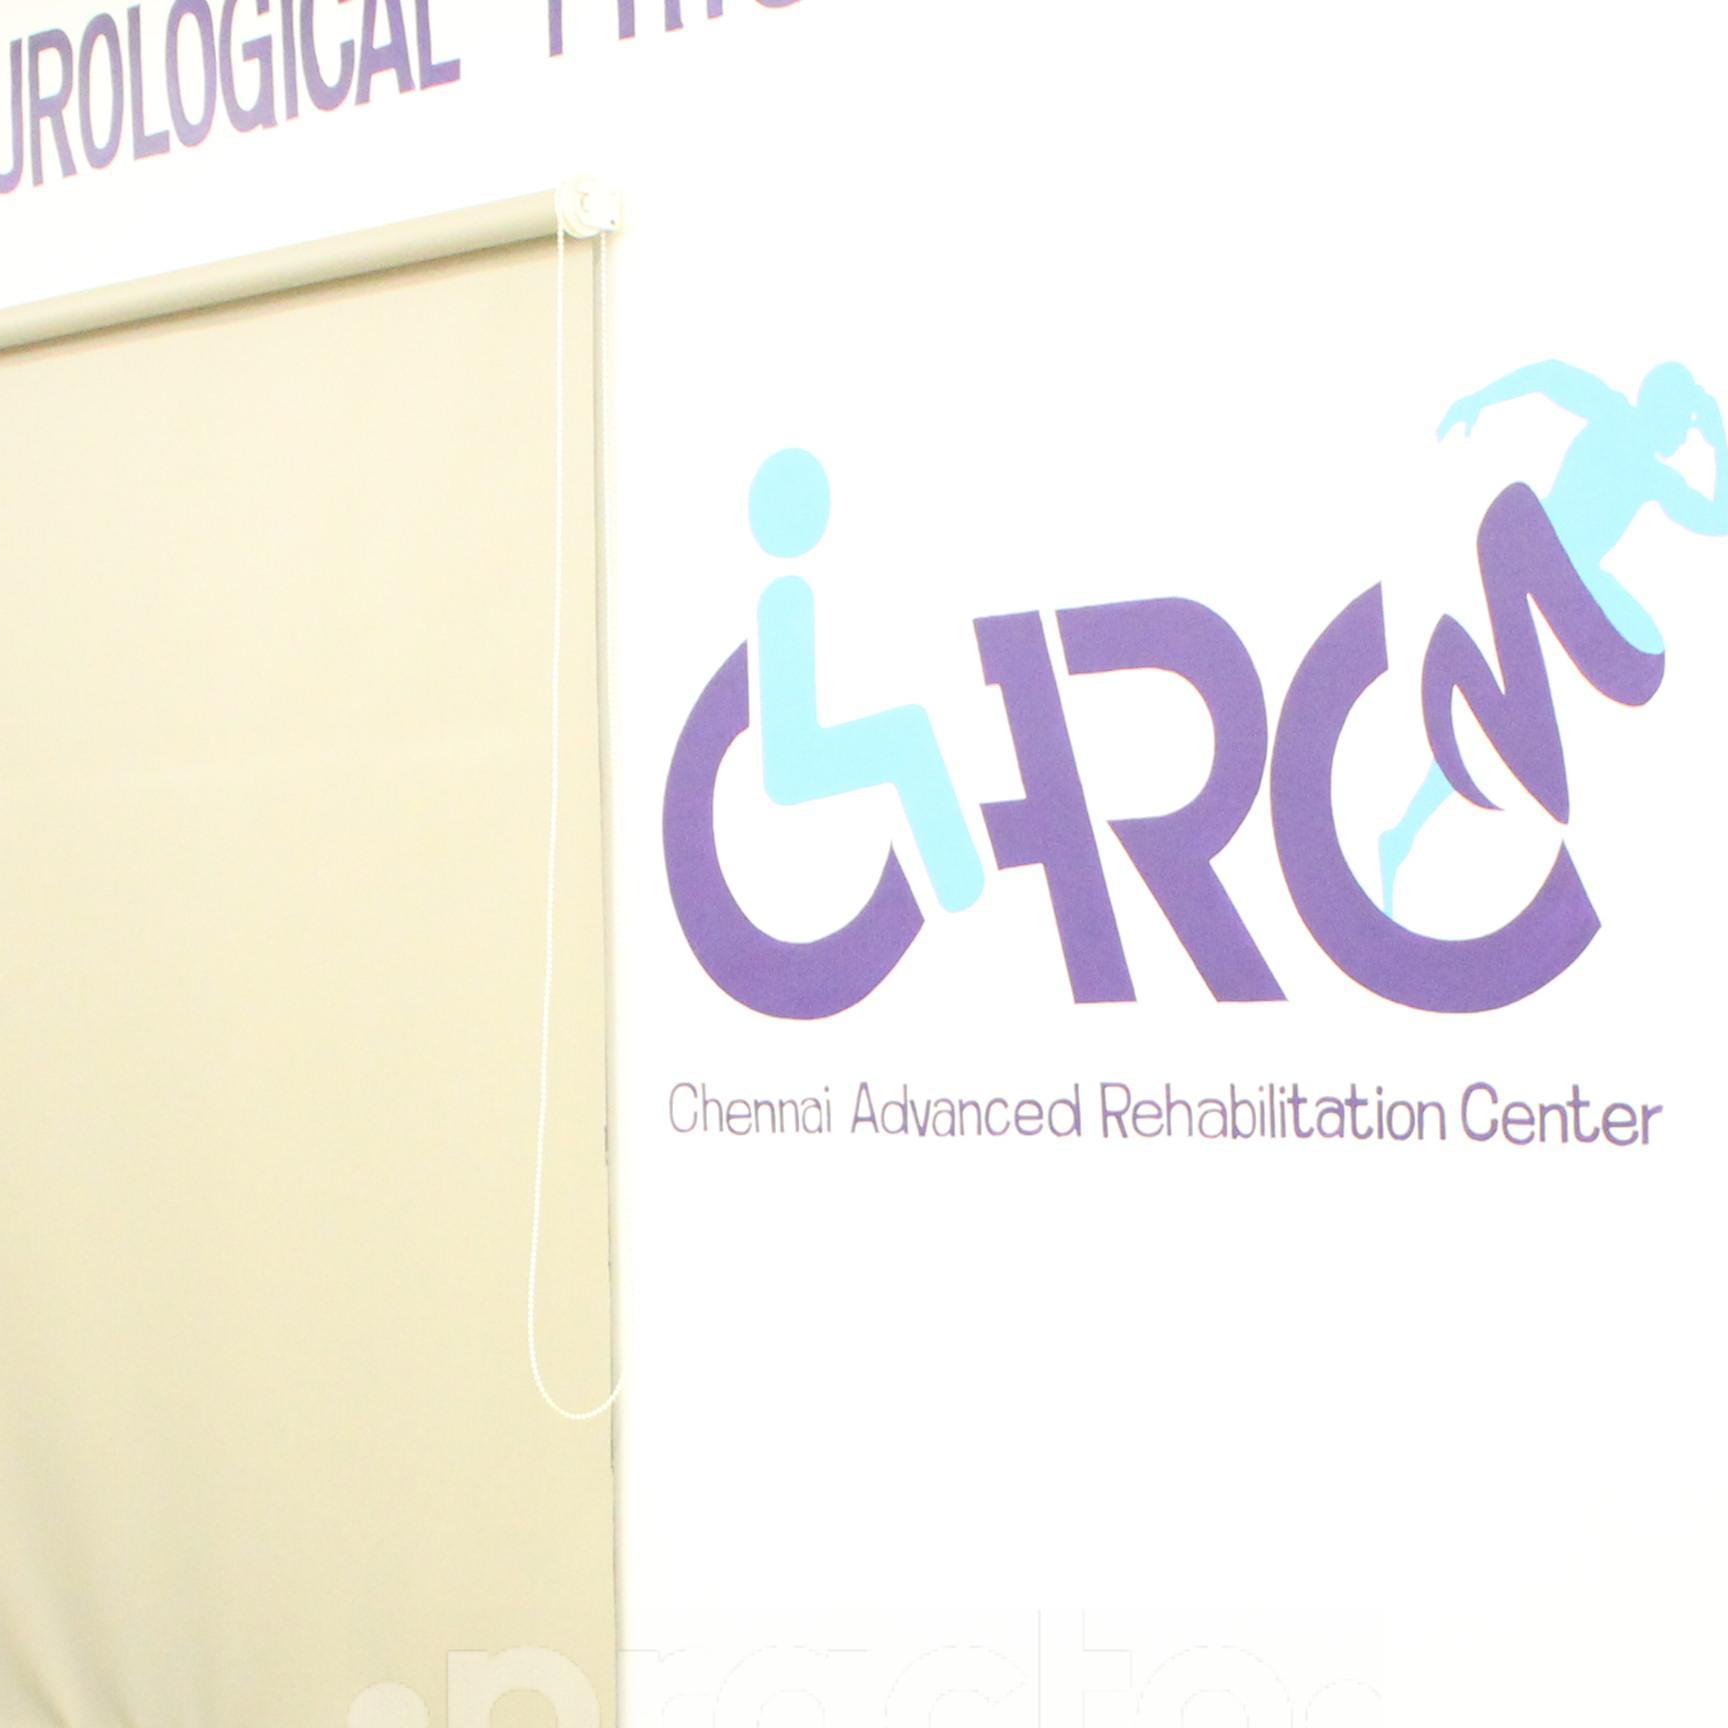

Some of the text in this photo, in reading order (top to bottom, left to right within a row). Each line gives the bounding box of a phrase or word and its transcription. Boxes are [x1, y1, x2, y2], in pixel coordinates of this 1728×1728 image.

[668, 1080, 1664, 1146] Chennai Advanced Rehabilitation Center
